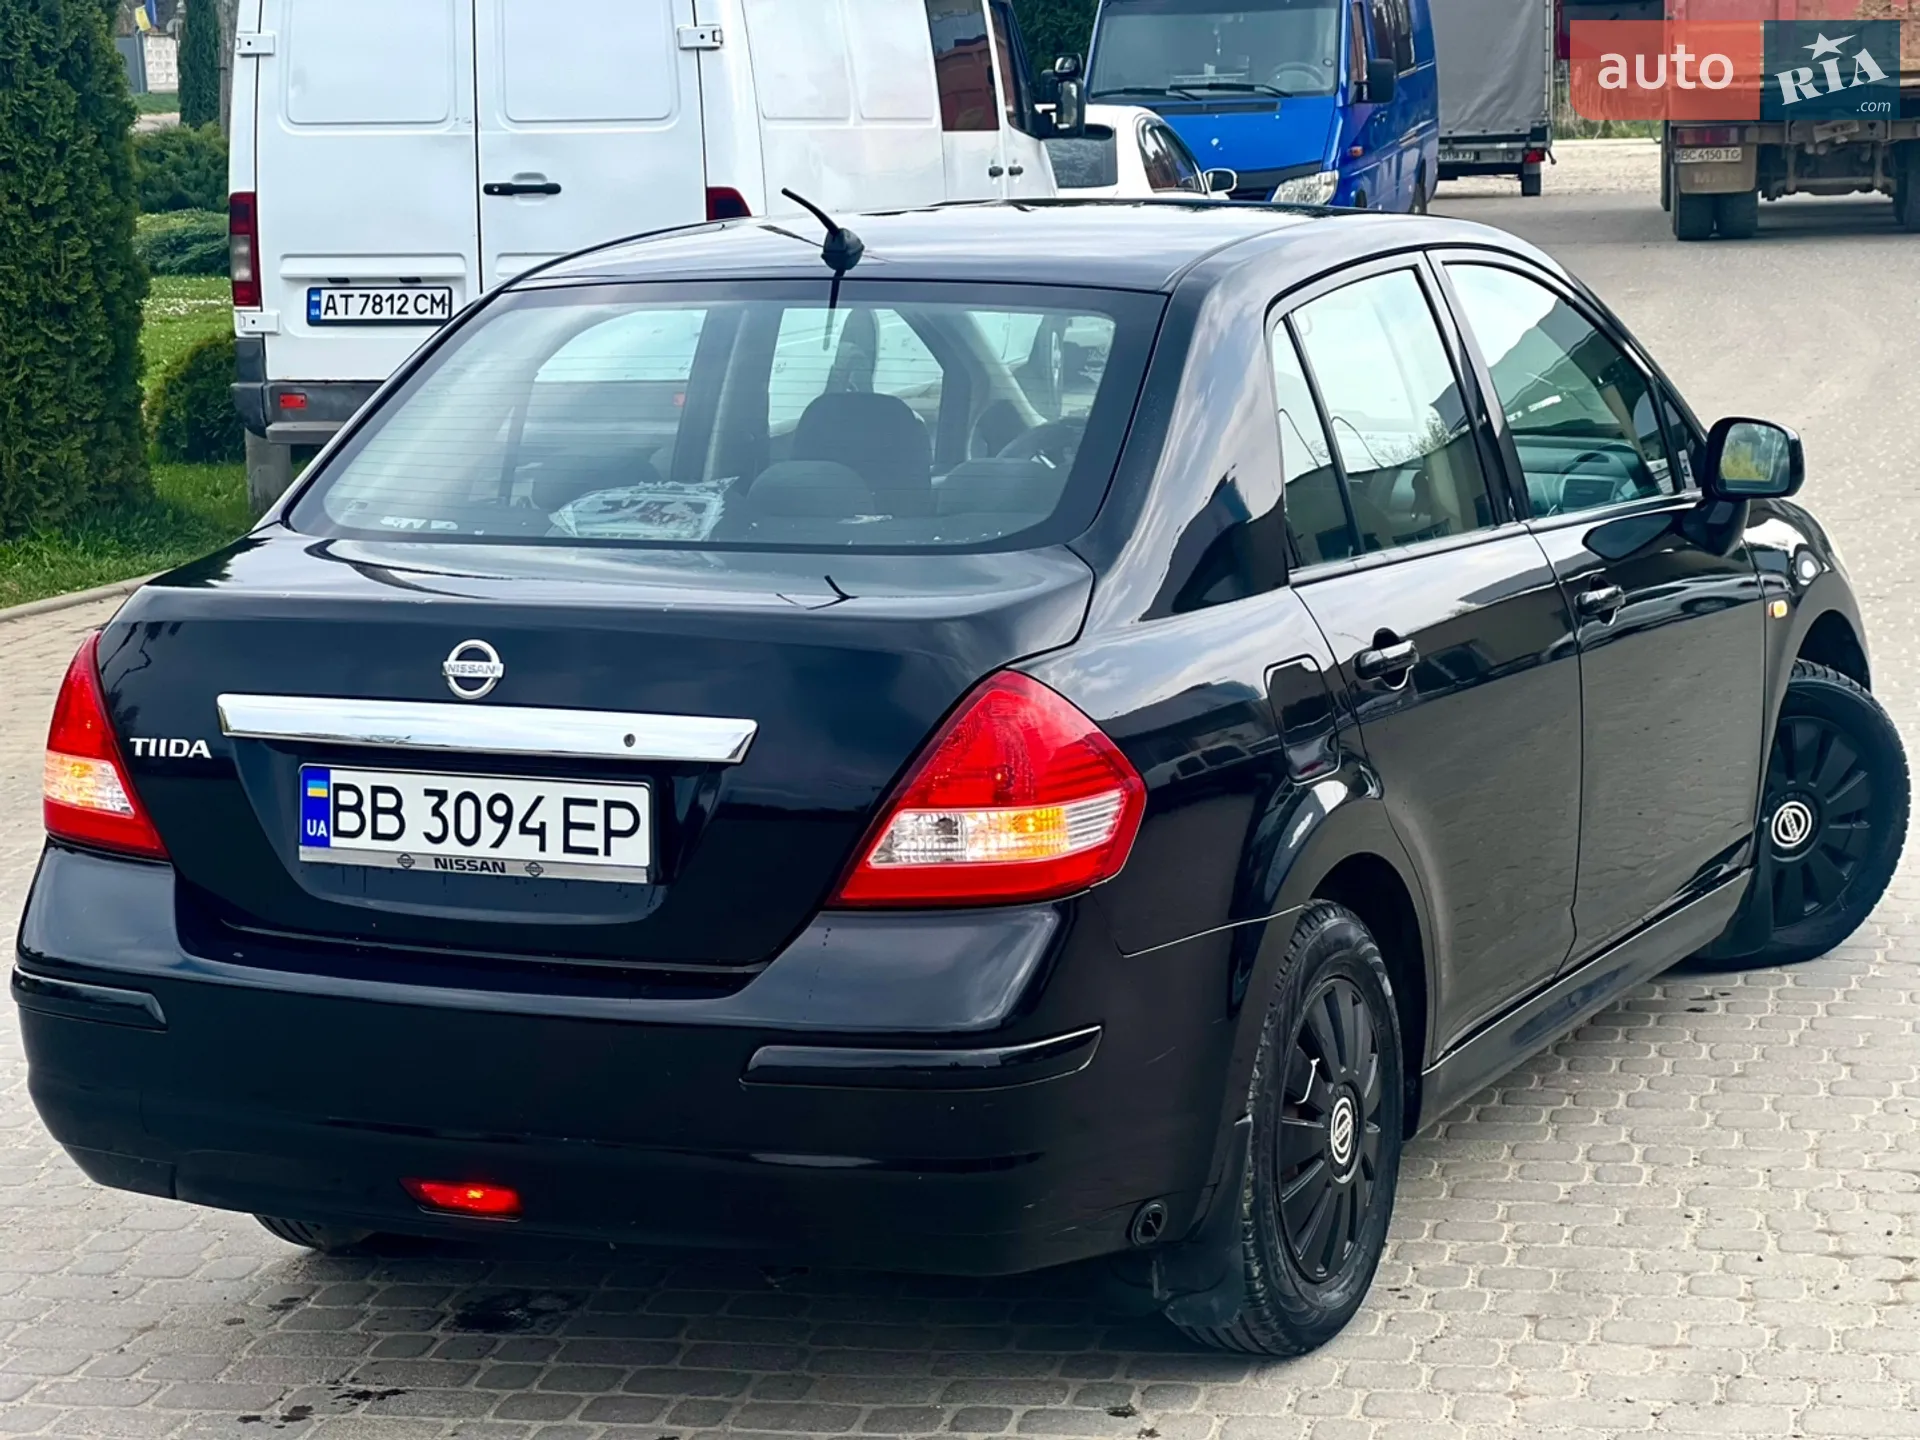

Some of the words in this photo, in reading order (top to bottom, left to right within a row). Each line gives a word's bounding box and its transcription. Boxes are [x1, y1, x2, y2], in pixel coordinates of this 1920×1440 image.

[1681, 149, 1697, 160] BC
[1698, 149, 1722, 160] 4150
[323, 294, 354, 315] AT
[359, 294, 409, 315] 7812
[413, 293, 446, 315] CM
[447, 664, 496, 675] NISSAN
[129, 737, 212, 759] TIIDA
[307, 818, 328, 838] UA
[332, 782, 406, 842] BB
[422, 788, 546, 853] 3094
[562, 797, 641, 857] EP
[434, 857, 506, 874] NISSAN
